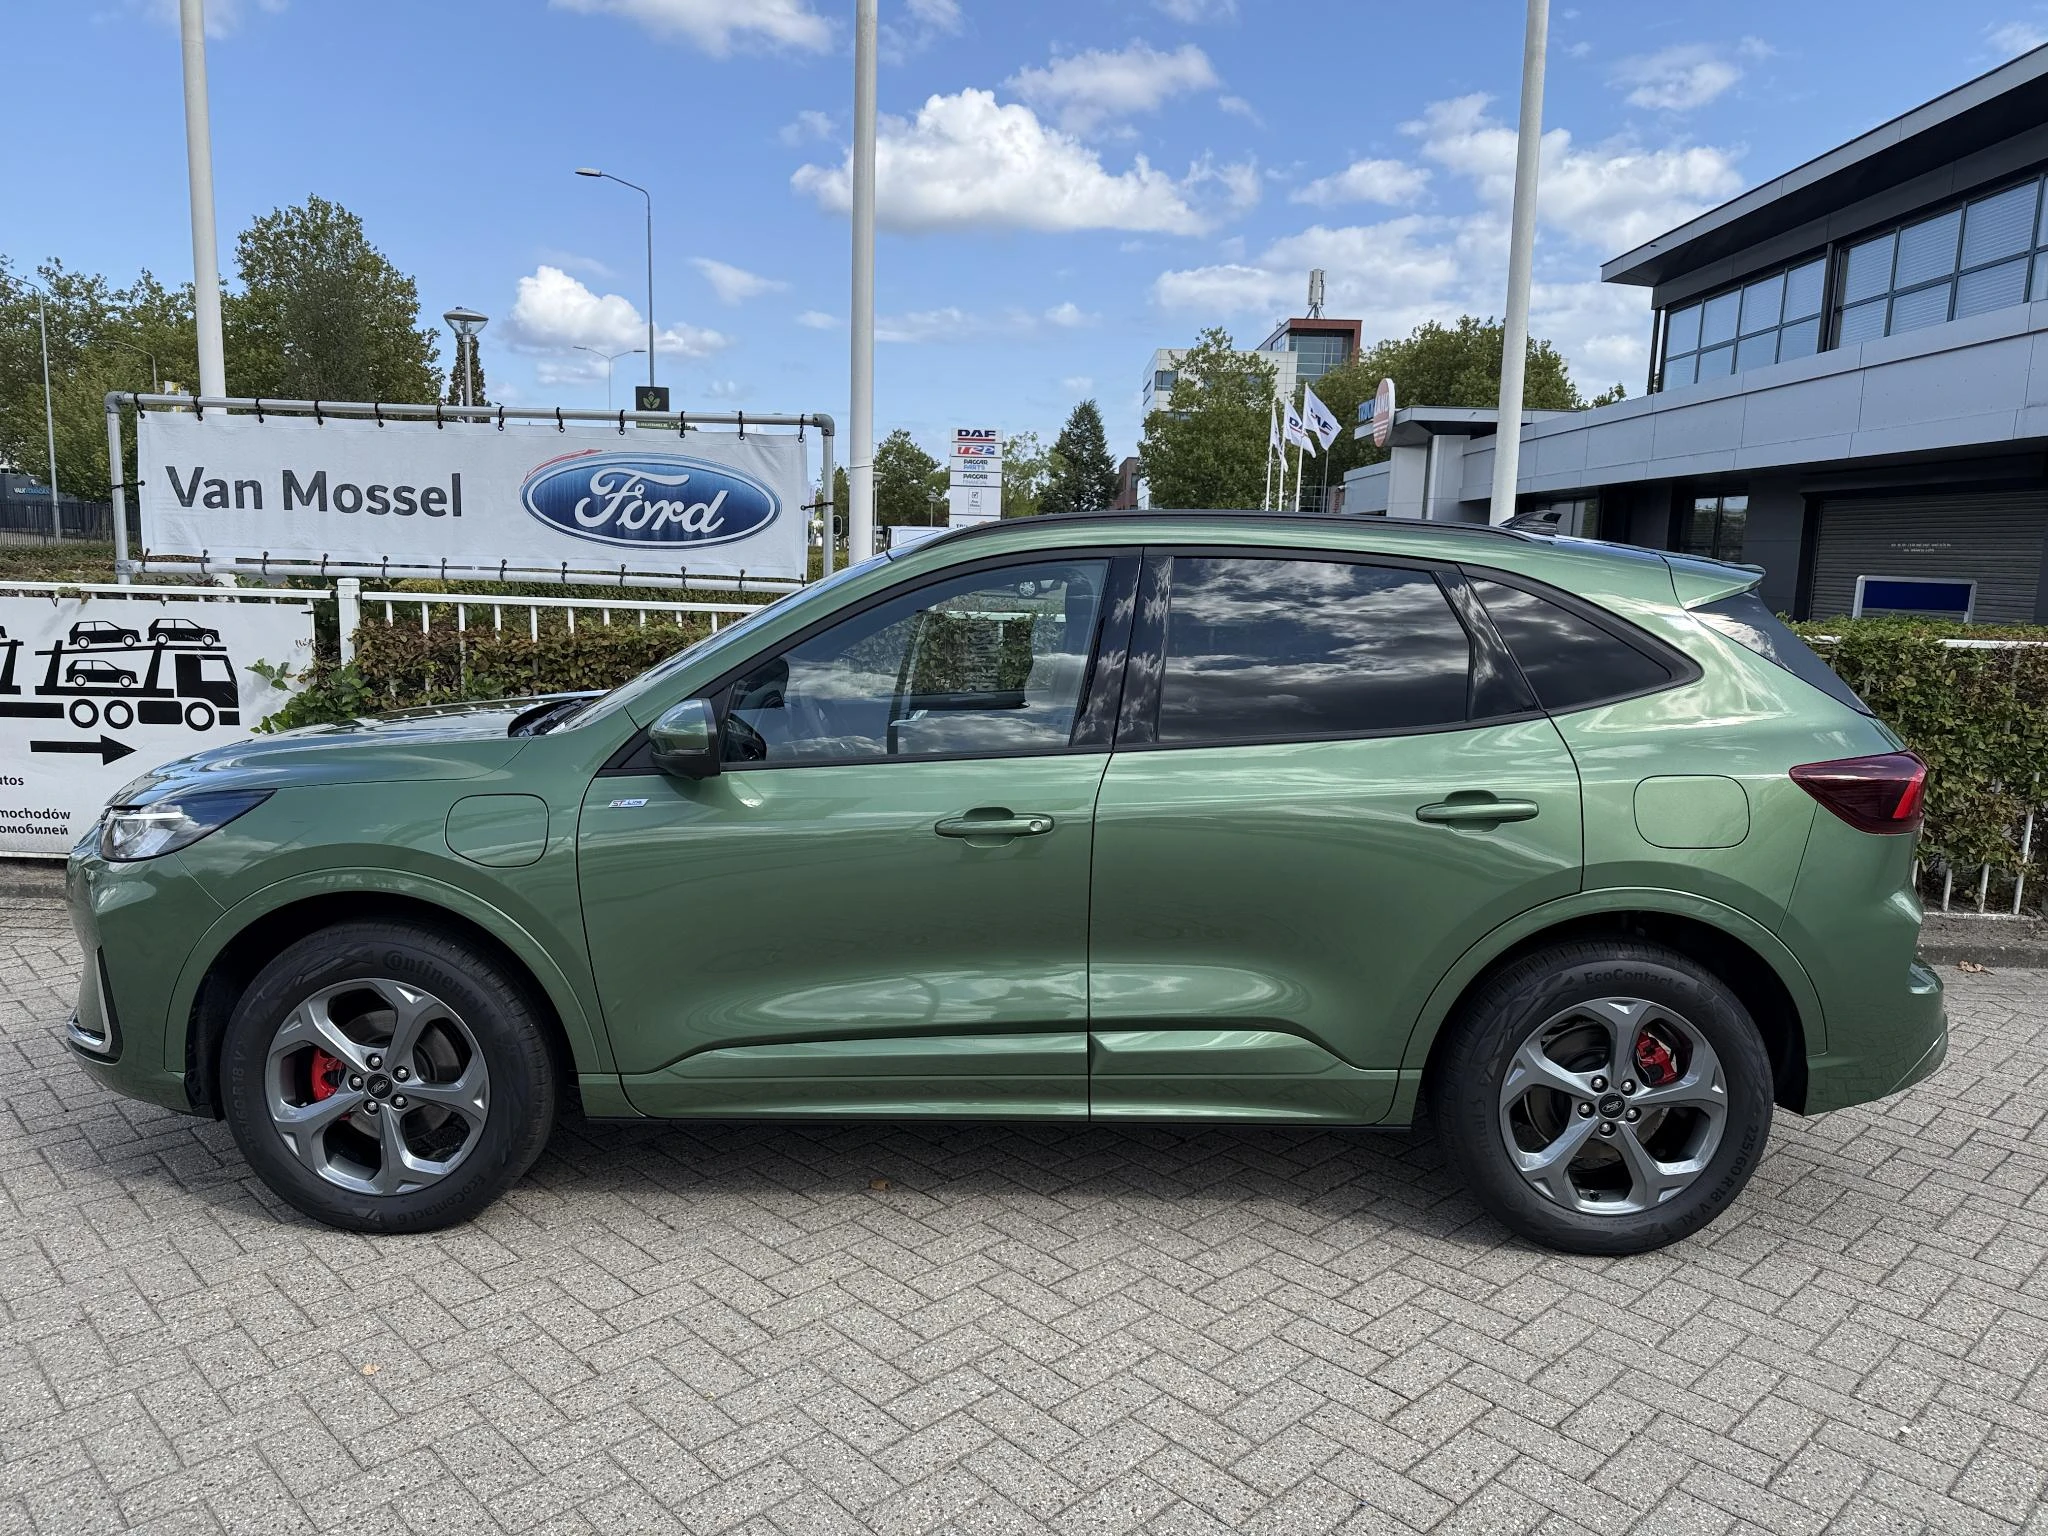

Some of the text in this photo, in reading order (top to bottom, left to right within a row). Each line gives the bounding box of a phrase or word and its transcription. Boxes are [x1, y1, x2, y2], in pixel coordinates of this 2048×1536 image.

[957, 429, 996, 437] DAF
[165, 465, 462, 517] Van Mossel
[574, 467, 729, 534] Ford
